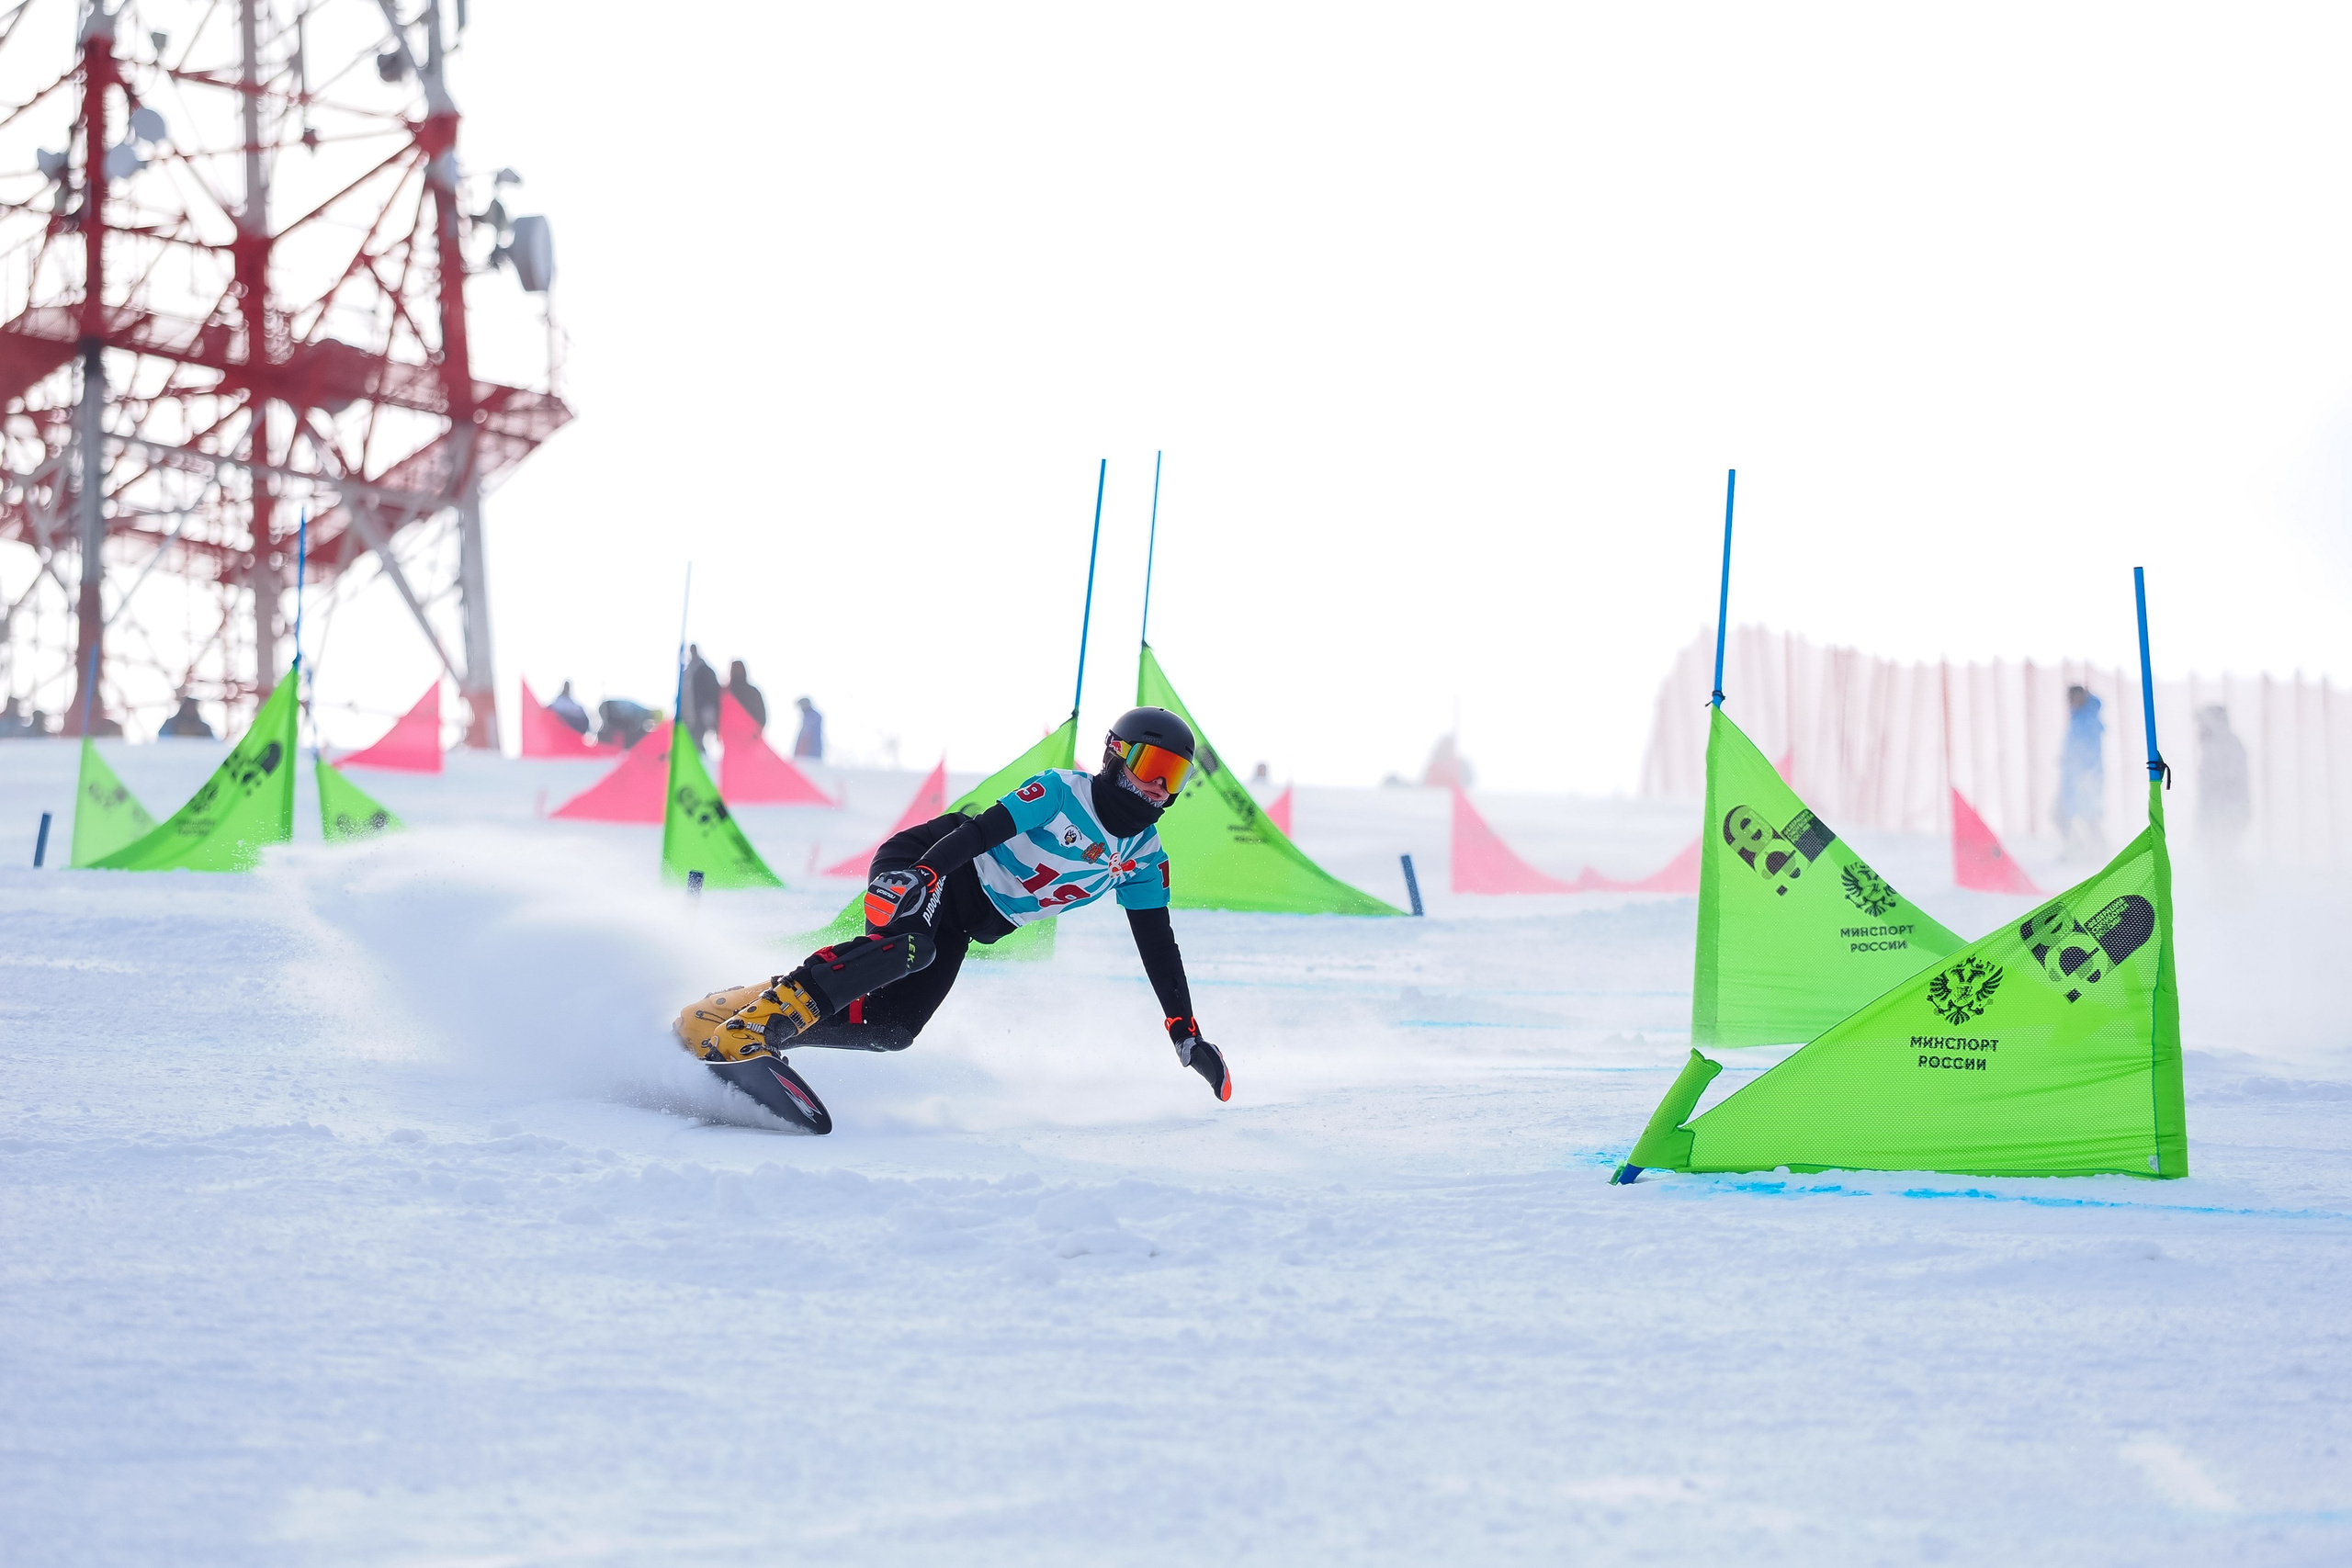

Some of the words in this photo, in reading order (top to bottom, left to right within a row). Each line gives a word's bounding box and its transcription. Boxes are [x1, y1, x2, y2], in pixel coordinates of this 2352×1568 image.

[1840, 924, 1915, 938] МИНСПОРТ
[1850, 940, 1907, 953] РОССИИ
[1910, 1035, 1999, 1052] МИНСПОРТ
[1918, 1055, 1986, 1071] РОССИИ
